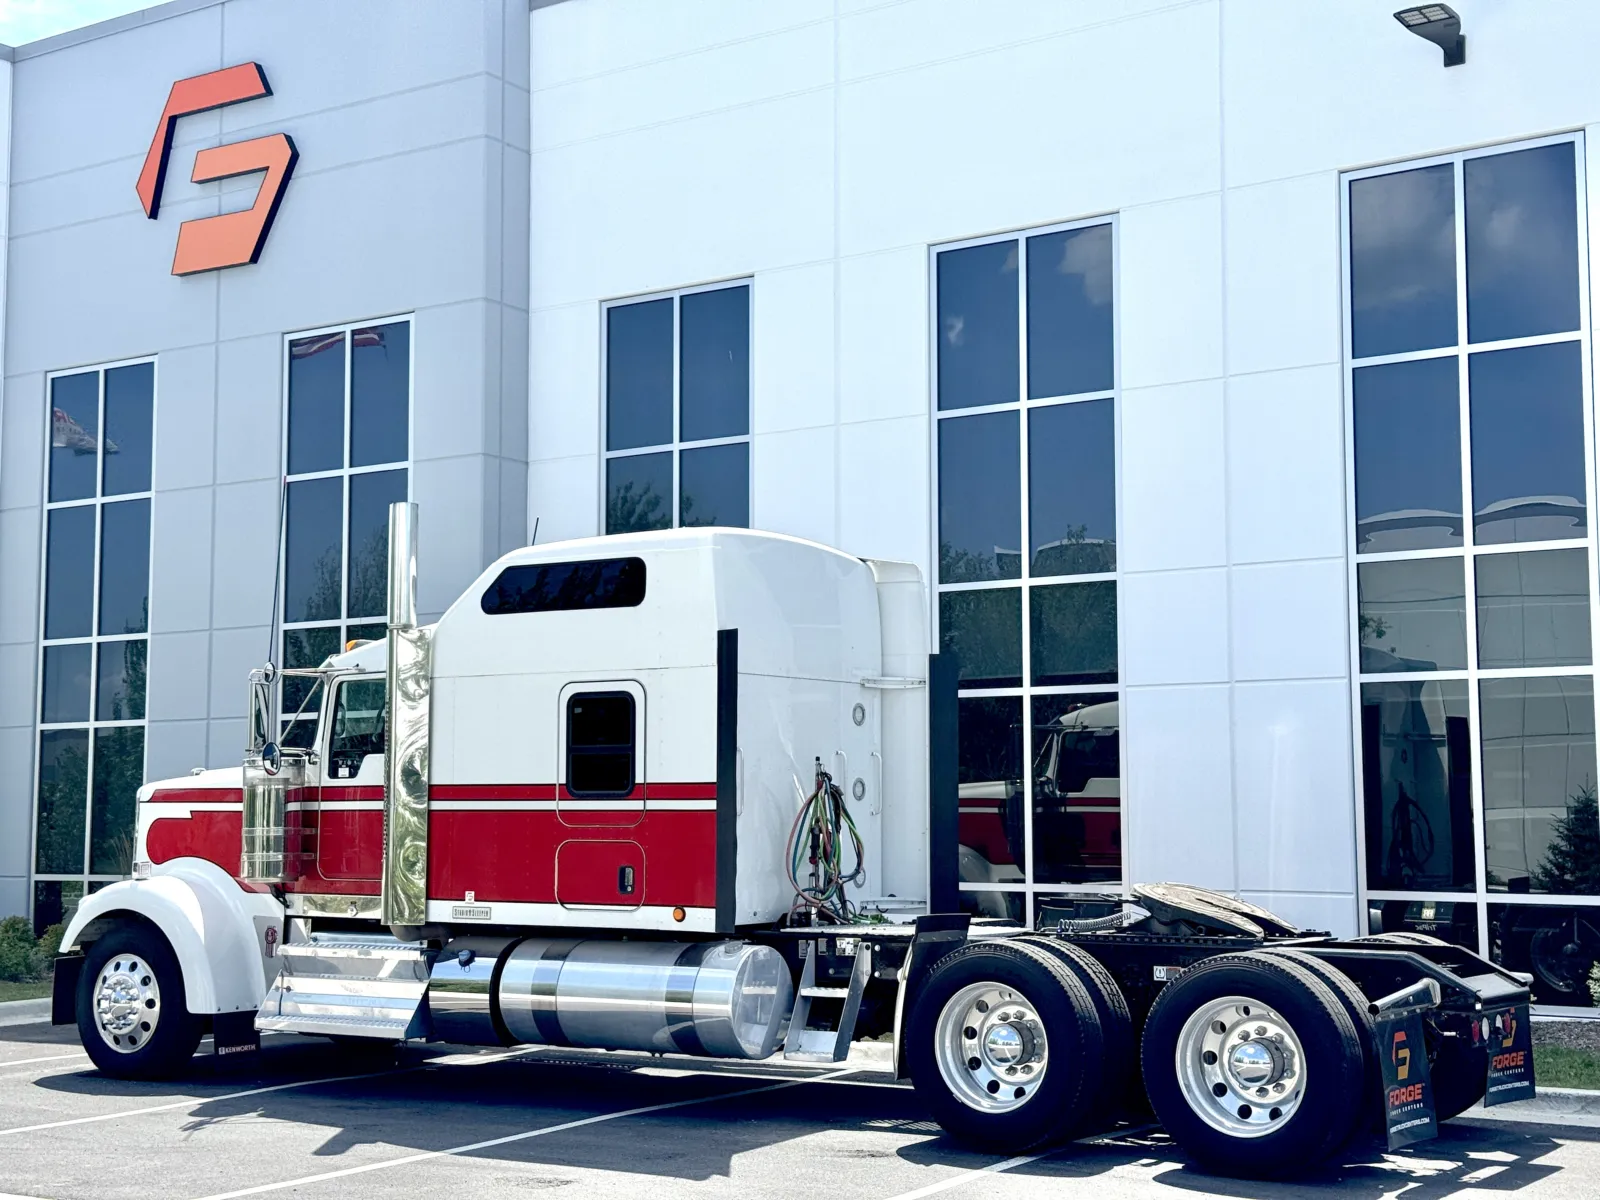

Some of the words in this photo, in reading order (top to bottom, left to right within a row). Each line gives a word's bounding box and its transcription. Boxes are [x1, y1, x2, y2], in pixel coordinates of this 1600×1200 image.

[225, 1044, 256, 1053] KENWORTH
[1491, 1051, 1524, 1070] FORGE
[1388, 1083, 1422, 1108] FORGE
